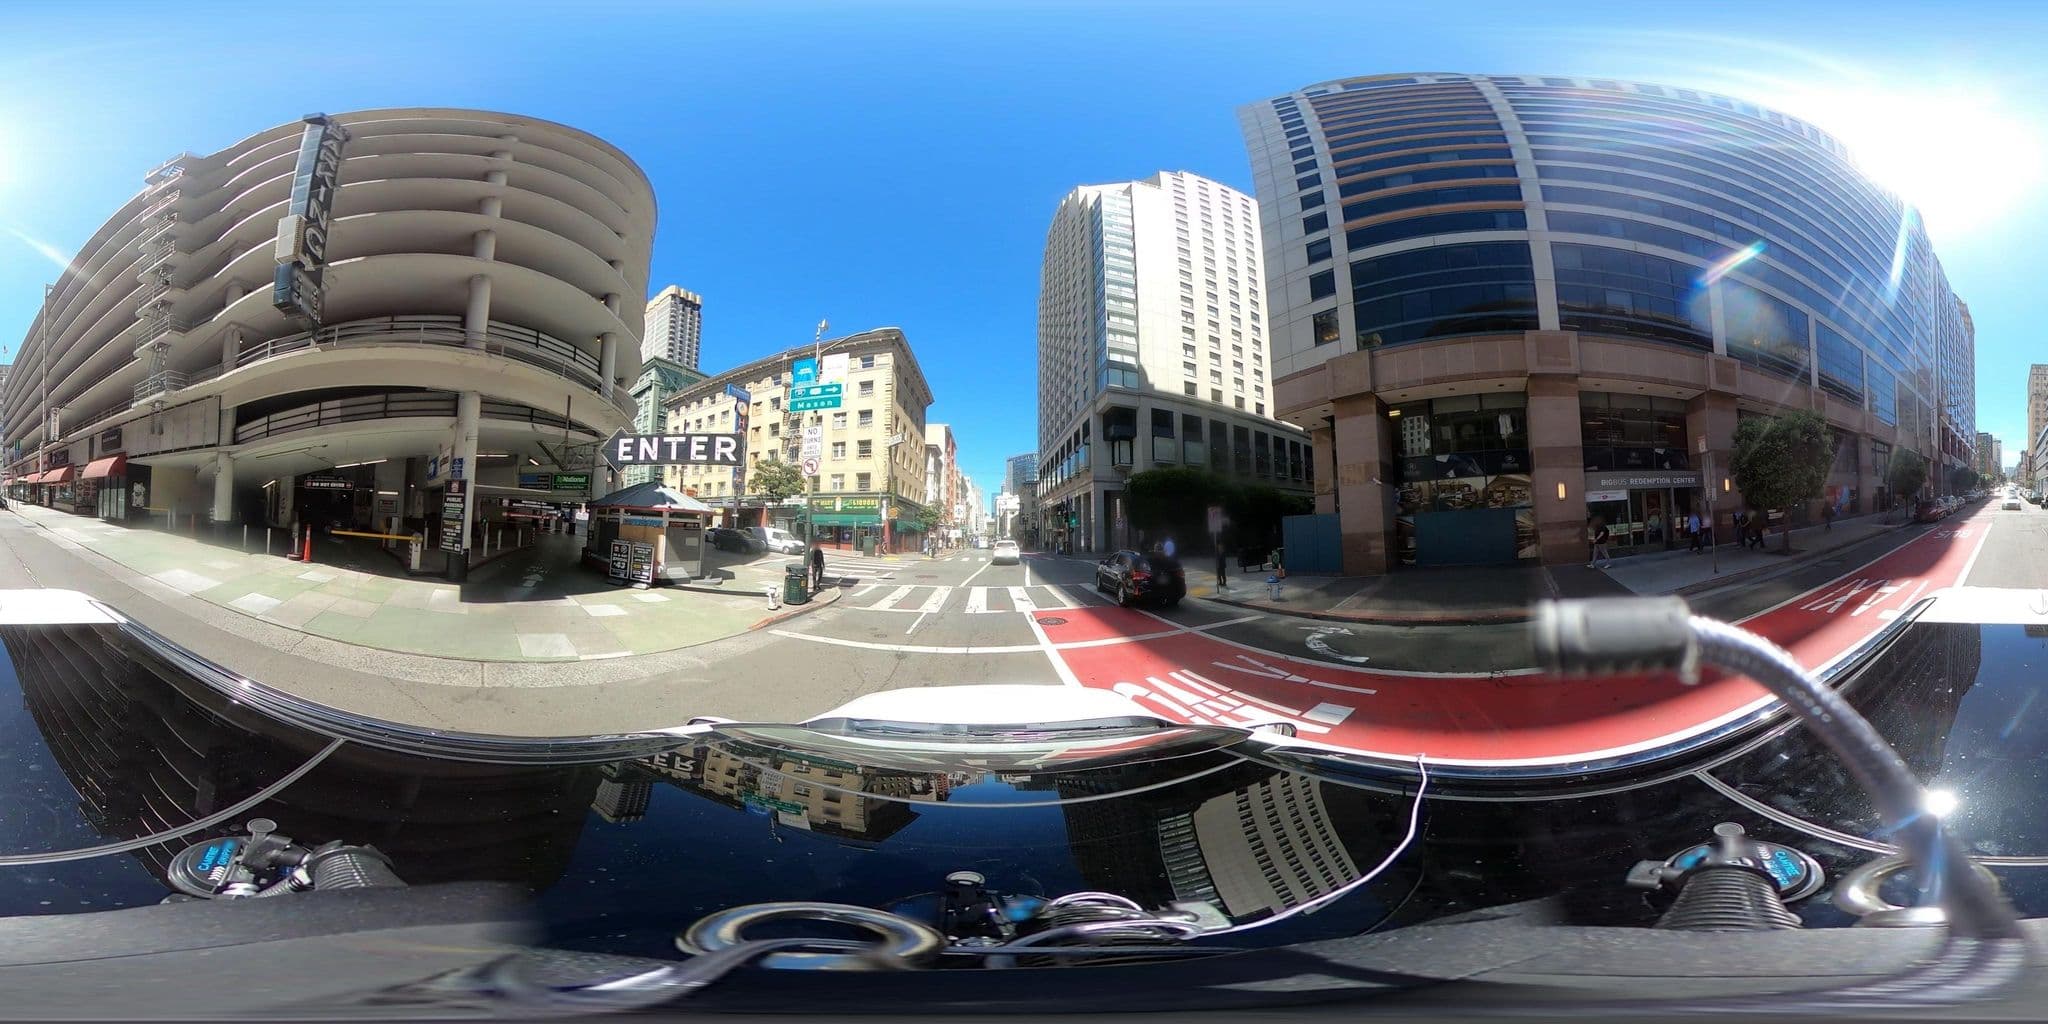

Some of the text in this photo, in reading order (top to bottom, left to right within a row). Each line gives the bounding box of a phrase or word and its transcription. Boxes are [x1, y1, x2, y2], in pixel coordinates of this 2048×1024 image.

[797, 401, 833, 409] Mason
[617, 436, 737, 462] ENTER
[1629, 477, 1671, 485] REDEMPTION
